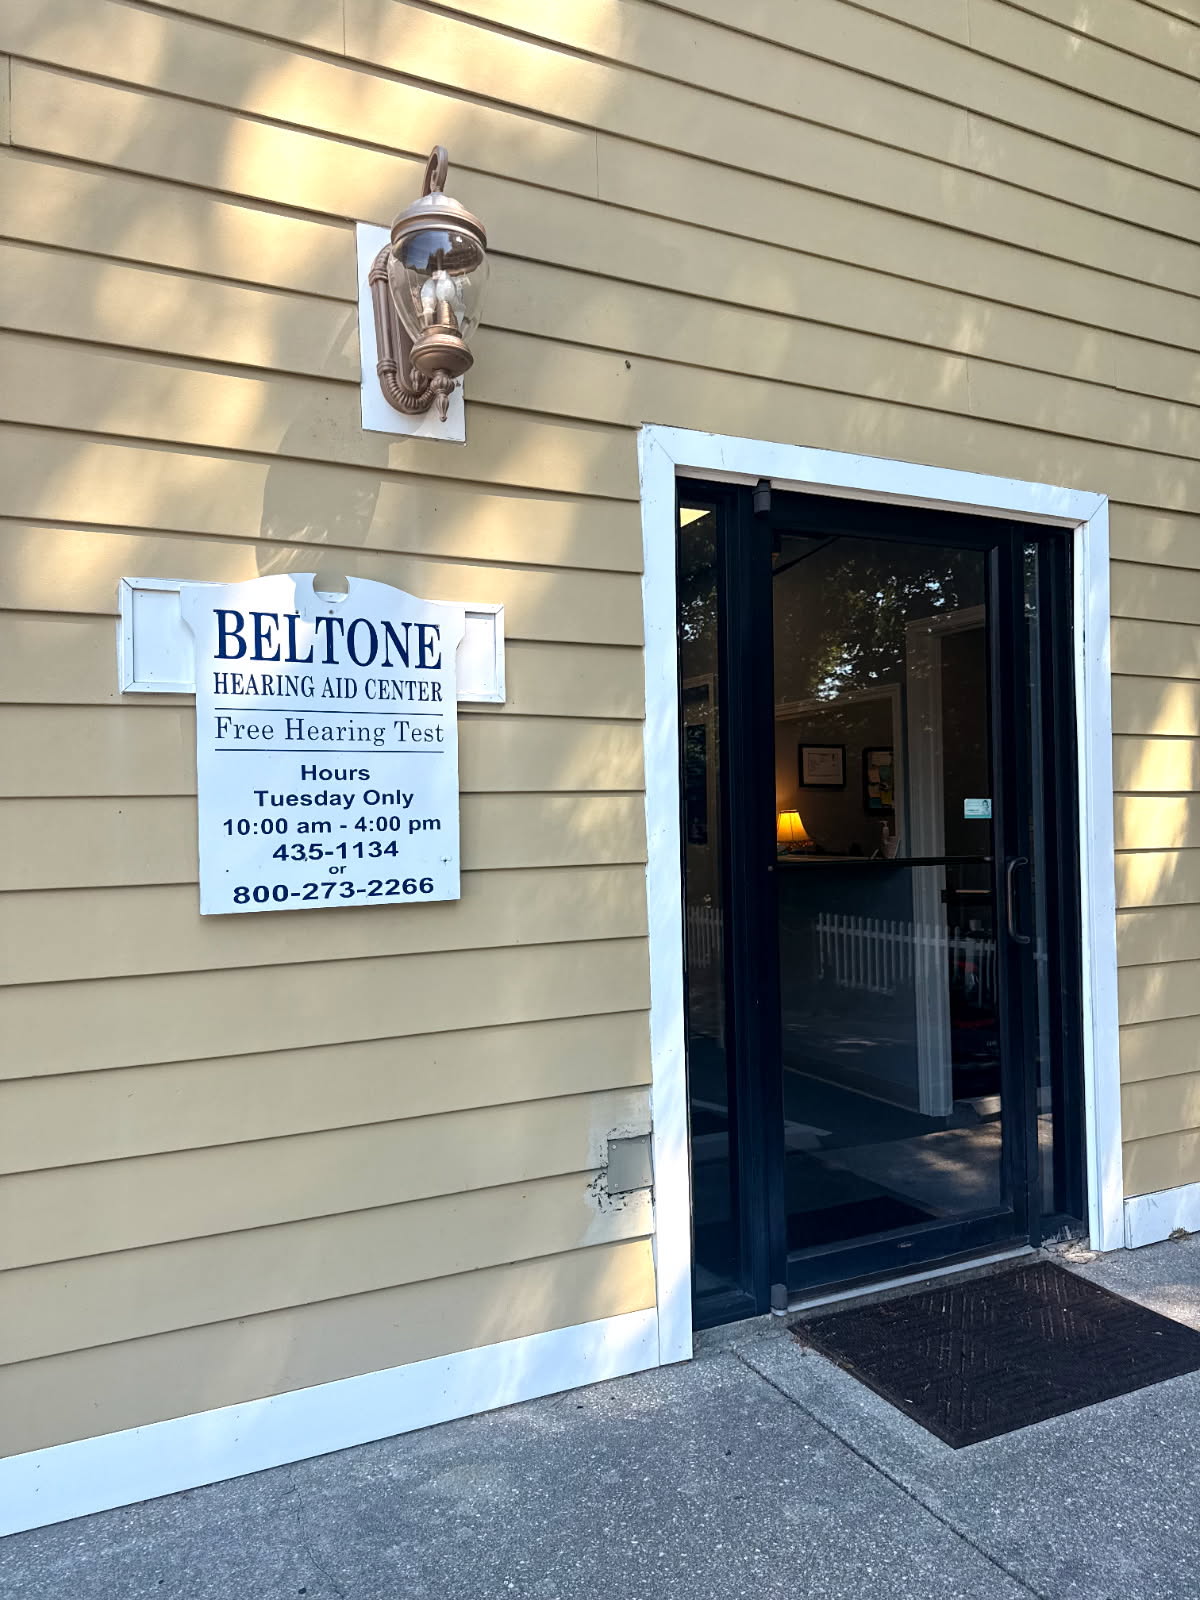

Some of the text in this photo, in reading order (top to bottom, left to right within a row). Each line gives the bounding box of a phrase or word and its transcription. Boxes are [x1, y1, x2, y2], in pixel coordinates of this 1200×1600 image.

[212, 608, 442, 670] BELTONE
[213, 672, 443, 702] HEARING AID CENTER
[214, 716, 444, 746] Free Hearing Test
[300, 764, 371, 781] Hours
[254, 789, 414, 810] Tuesday Only
[223, 818, 288, 836] 10:00
[297, 819, 332, 834] am
[354, 815, 401, 832] 4:00
[408, 817, 442, 834] pm
[272, 840, 399, 861] 435-1134
[328, 865, 347, 875] or
[233, 877, 435, 904] 800-273-2266
